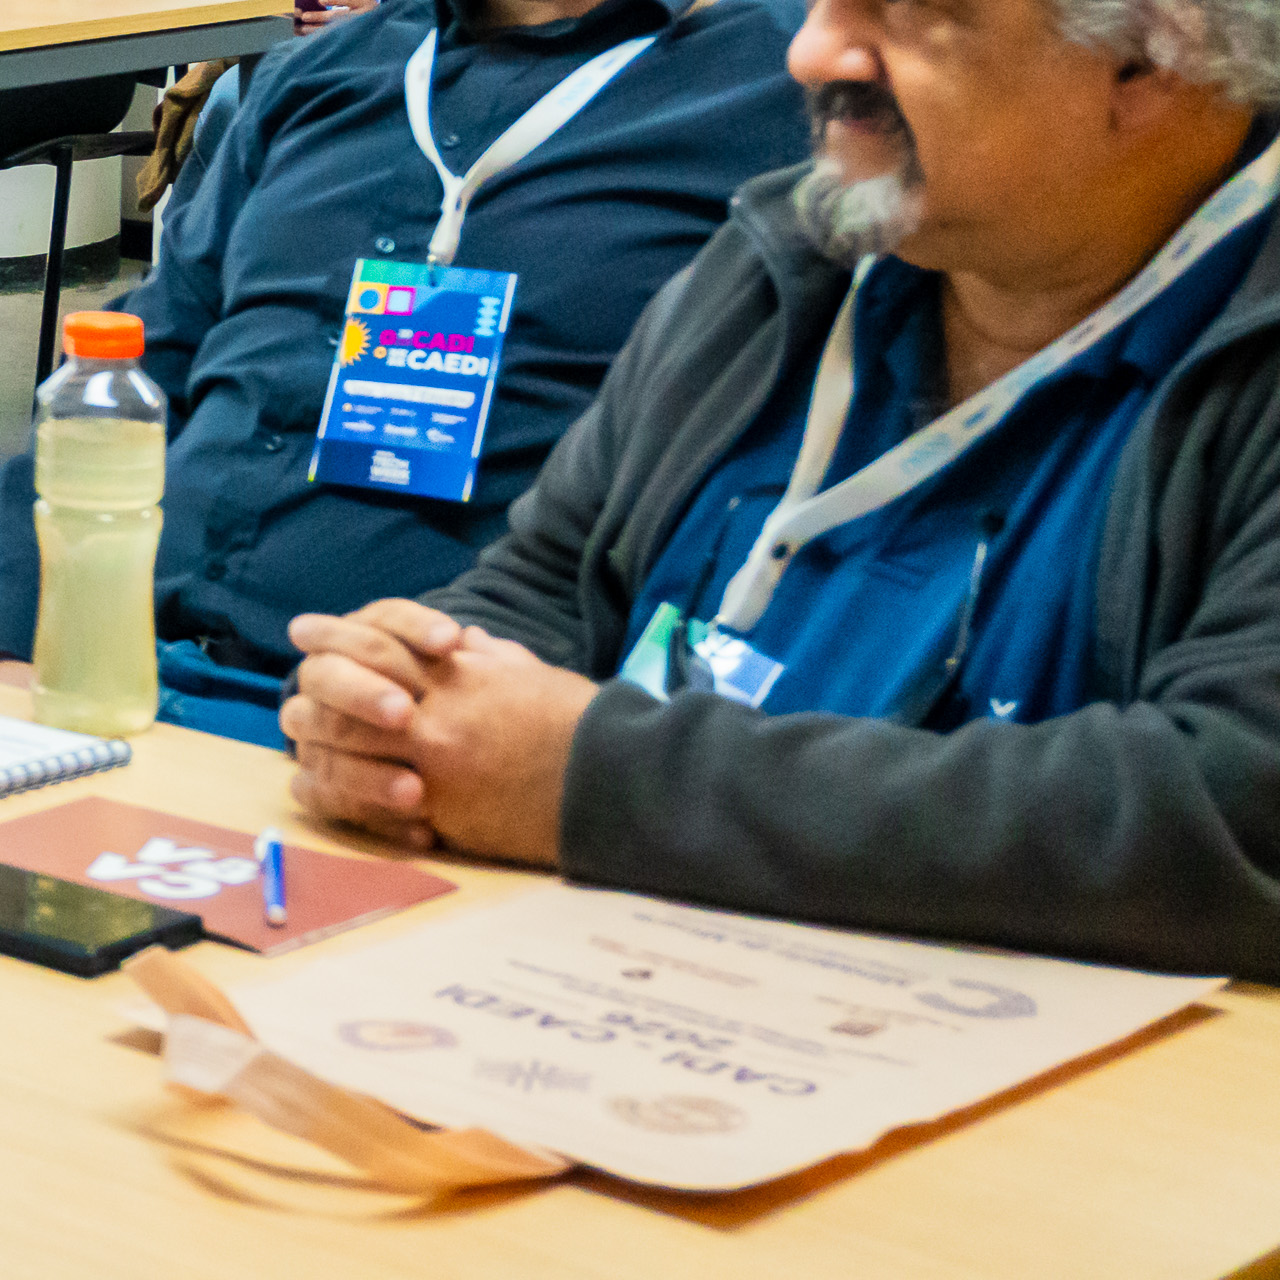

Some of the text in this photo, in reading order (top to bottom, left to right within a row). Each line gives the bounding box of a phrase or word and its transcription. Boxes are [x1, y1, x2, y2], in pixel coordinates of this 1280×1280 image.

[412, 330, 475, 353] CADI
[406, 349, 490, 377] CAEDI
[431, 983, 619, 1045] CAEDI
[661, 1050, 819, 1098] CADI
